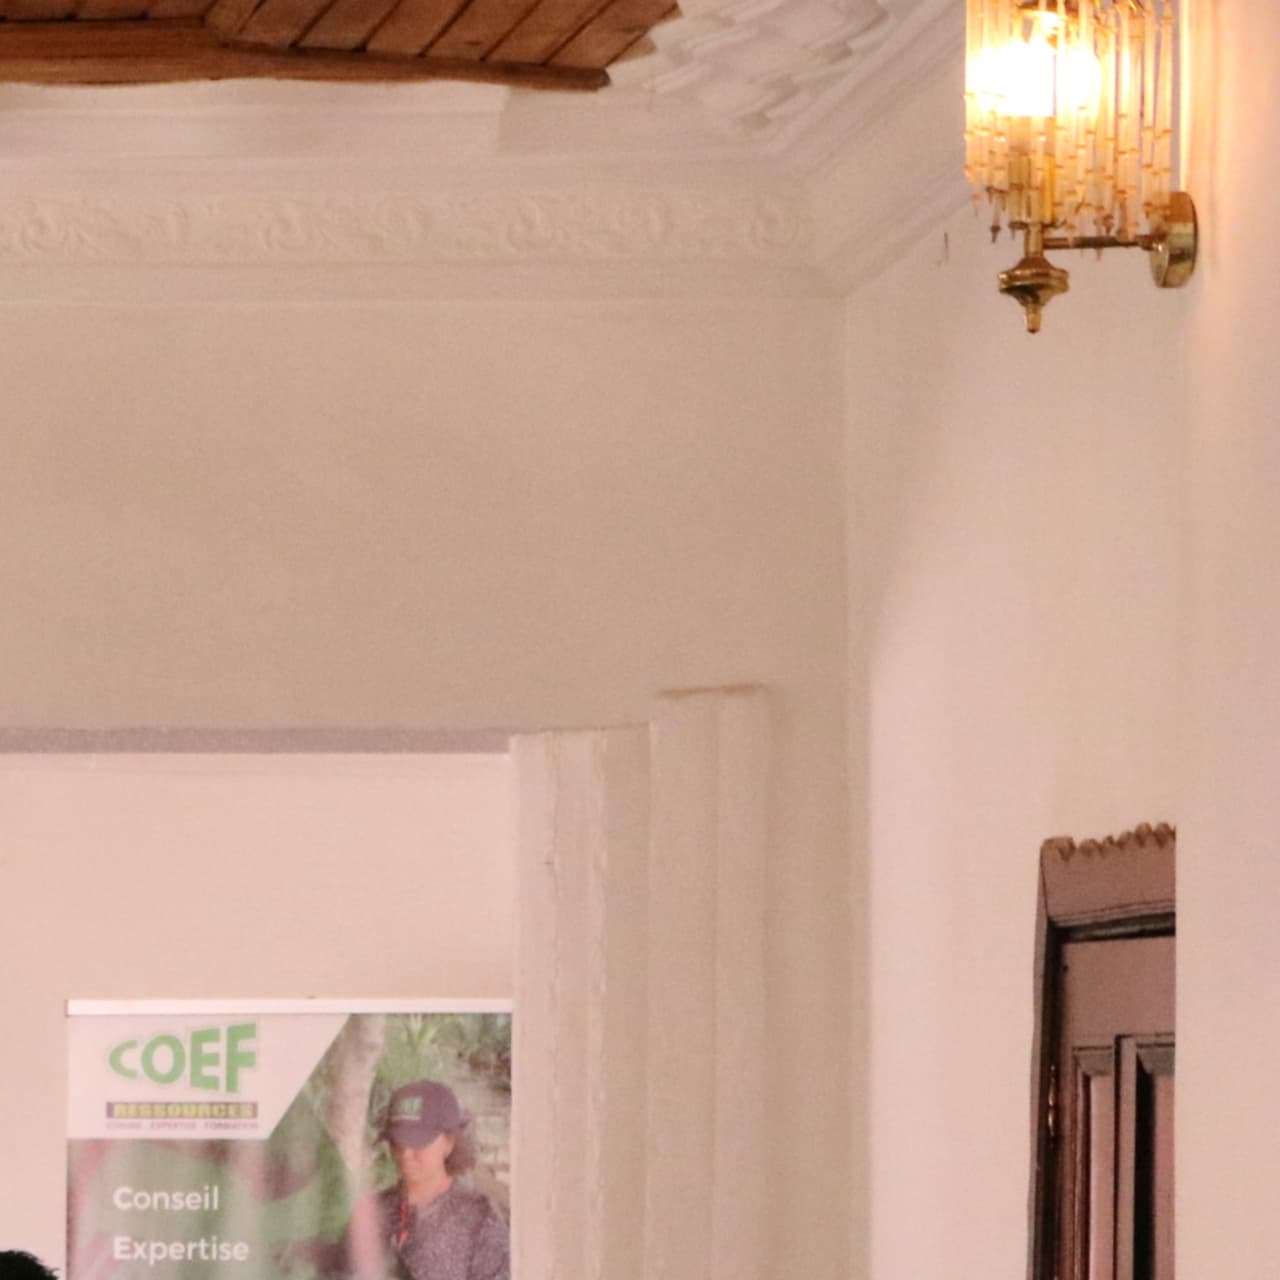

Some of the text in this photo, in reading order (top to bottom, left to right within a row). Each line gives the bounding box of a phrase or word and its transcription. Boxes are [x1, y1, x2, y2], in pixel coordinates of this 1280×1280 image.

[108, 1023, 257, 1093] COEF
[112, 1185, 220, 1211] Conseil
[112, 1236, 250, 1266] Expertise
